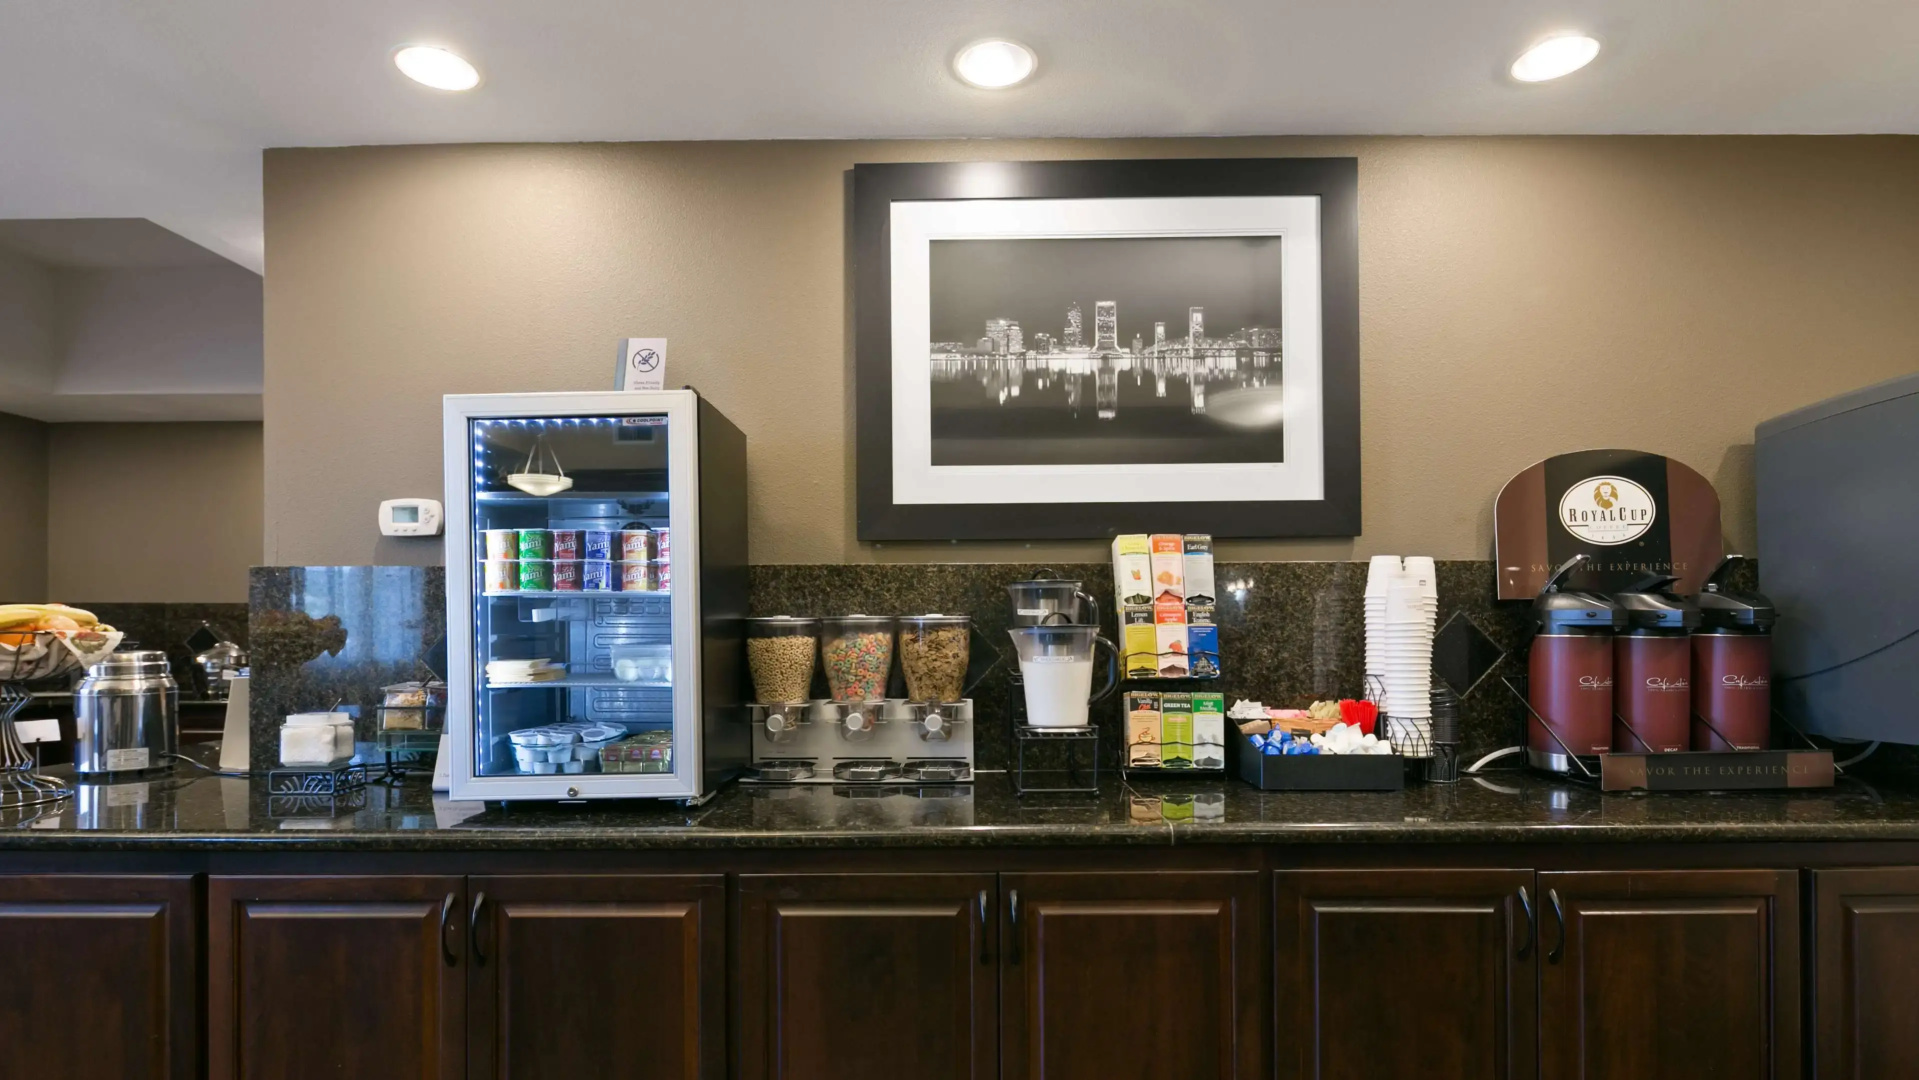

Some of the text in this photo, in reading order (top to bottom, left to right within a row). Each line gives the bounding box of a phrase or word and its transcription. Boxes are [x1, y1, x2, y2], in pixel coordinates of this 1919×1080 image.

[1187, 543, 1209, 552] Earl Grey
[1609, 562, 1689, 572] EXPERIENCE
[1629, 766, 1676, 777] SAVOR
[1684, 766, 1711, 776] THE
